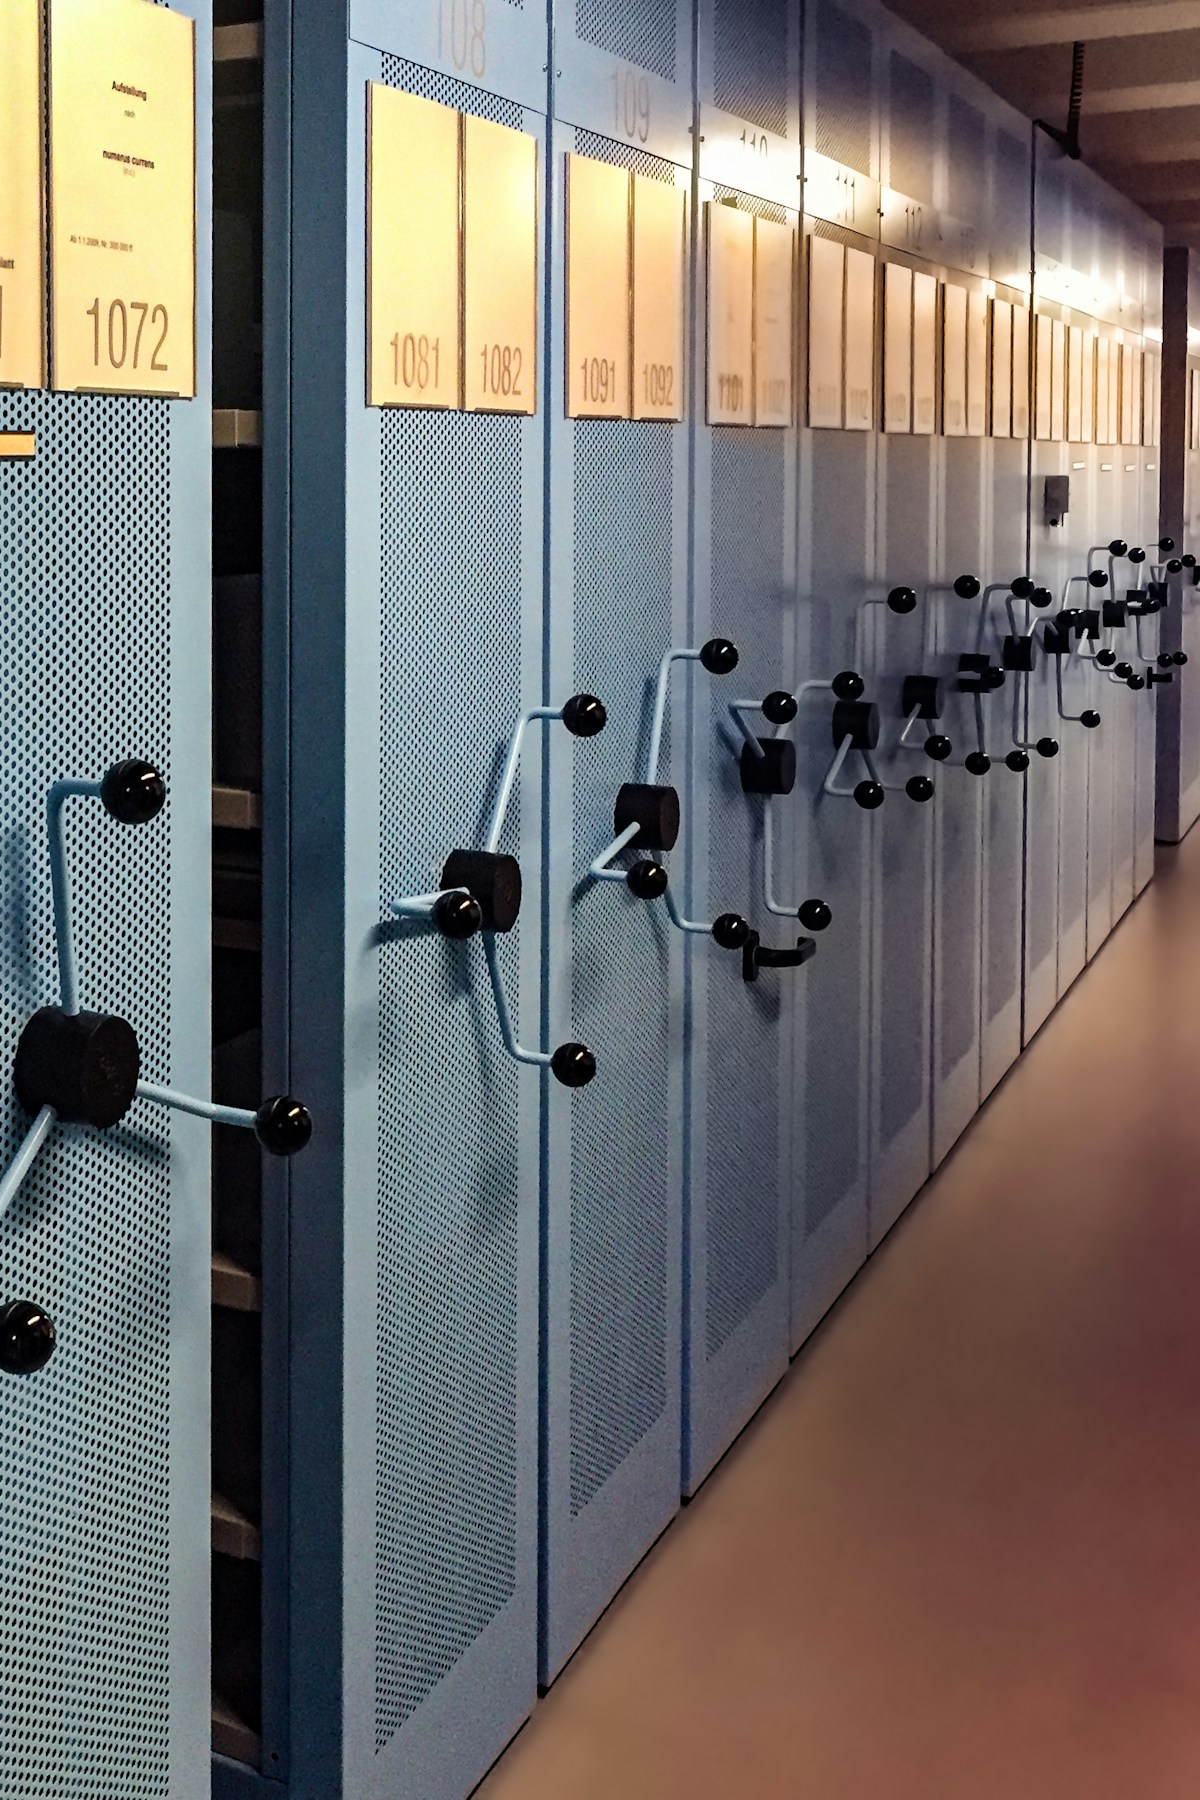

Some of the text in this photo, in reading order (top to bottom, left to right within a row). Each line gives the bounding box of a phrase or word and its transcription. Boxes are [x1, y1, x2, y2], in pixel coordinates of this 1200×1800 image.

[608, 64, 650, 144] 109
[86, 297, 169, 371] 1072
[390, 332, 439, 389] 1081
[481, 343, 522, 396] 1082
[581, 357, 615, 403] 1091
[643, 363, 674, 406] 1092
